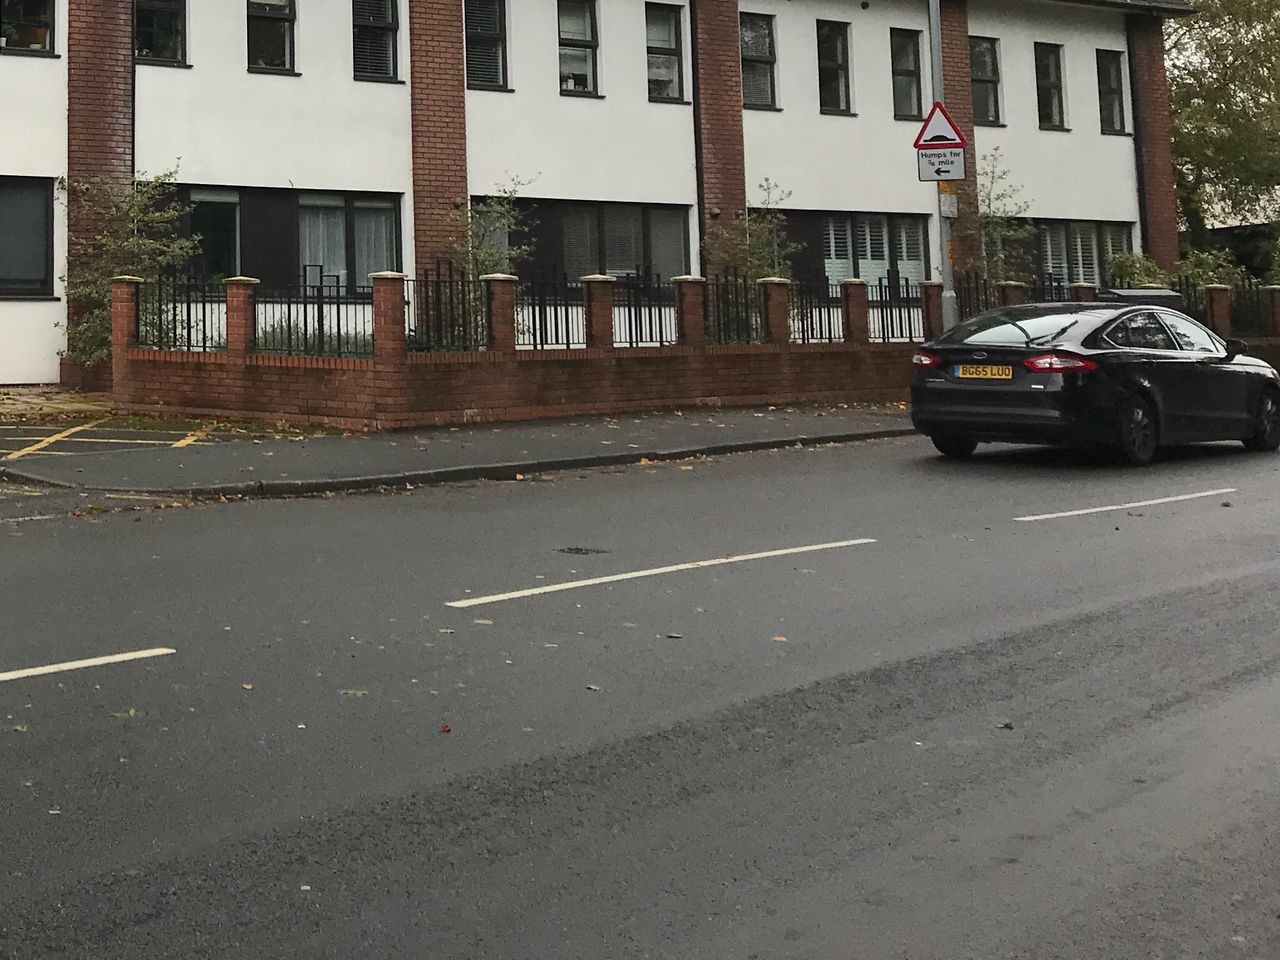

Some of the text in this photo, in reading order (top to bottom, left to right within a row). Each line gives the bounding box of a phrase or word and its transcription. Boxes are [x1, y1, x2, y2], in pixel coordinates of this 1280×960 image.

[920, 150, 961, 159] Humps for
[961, 365, 988, 376] BG65
